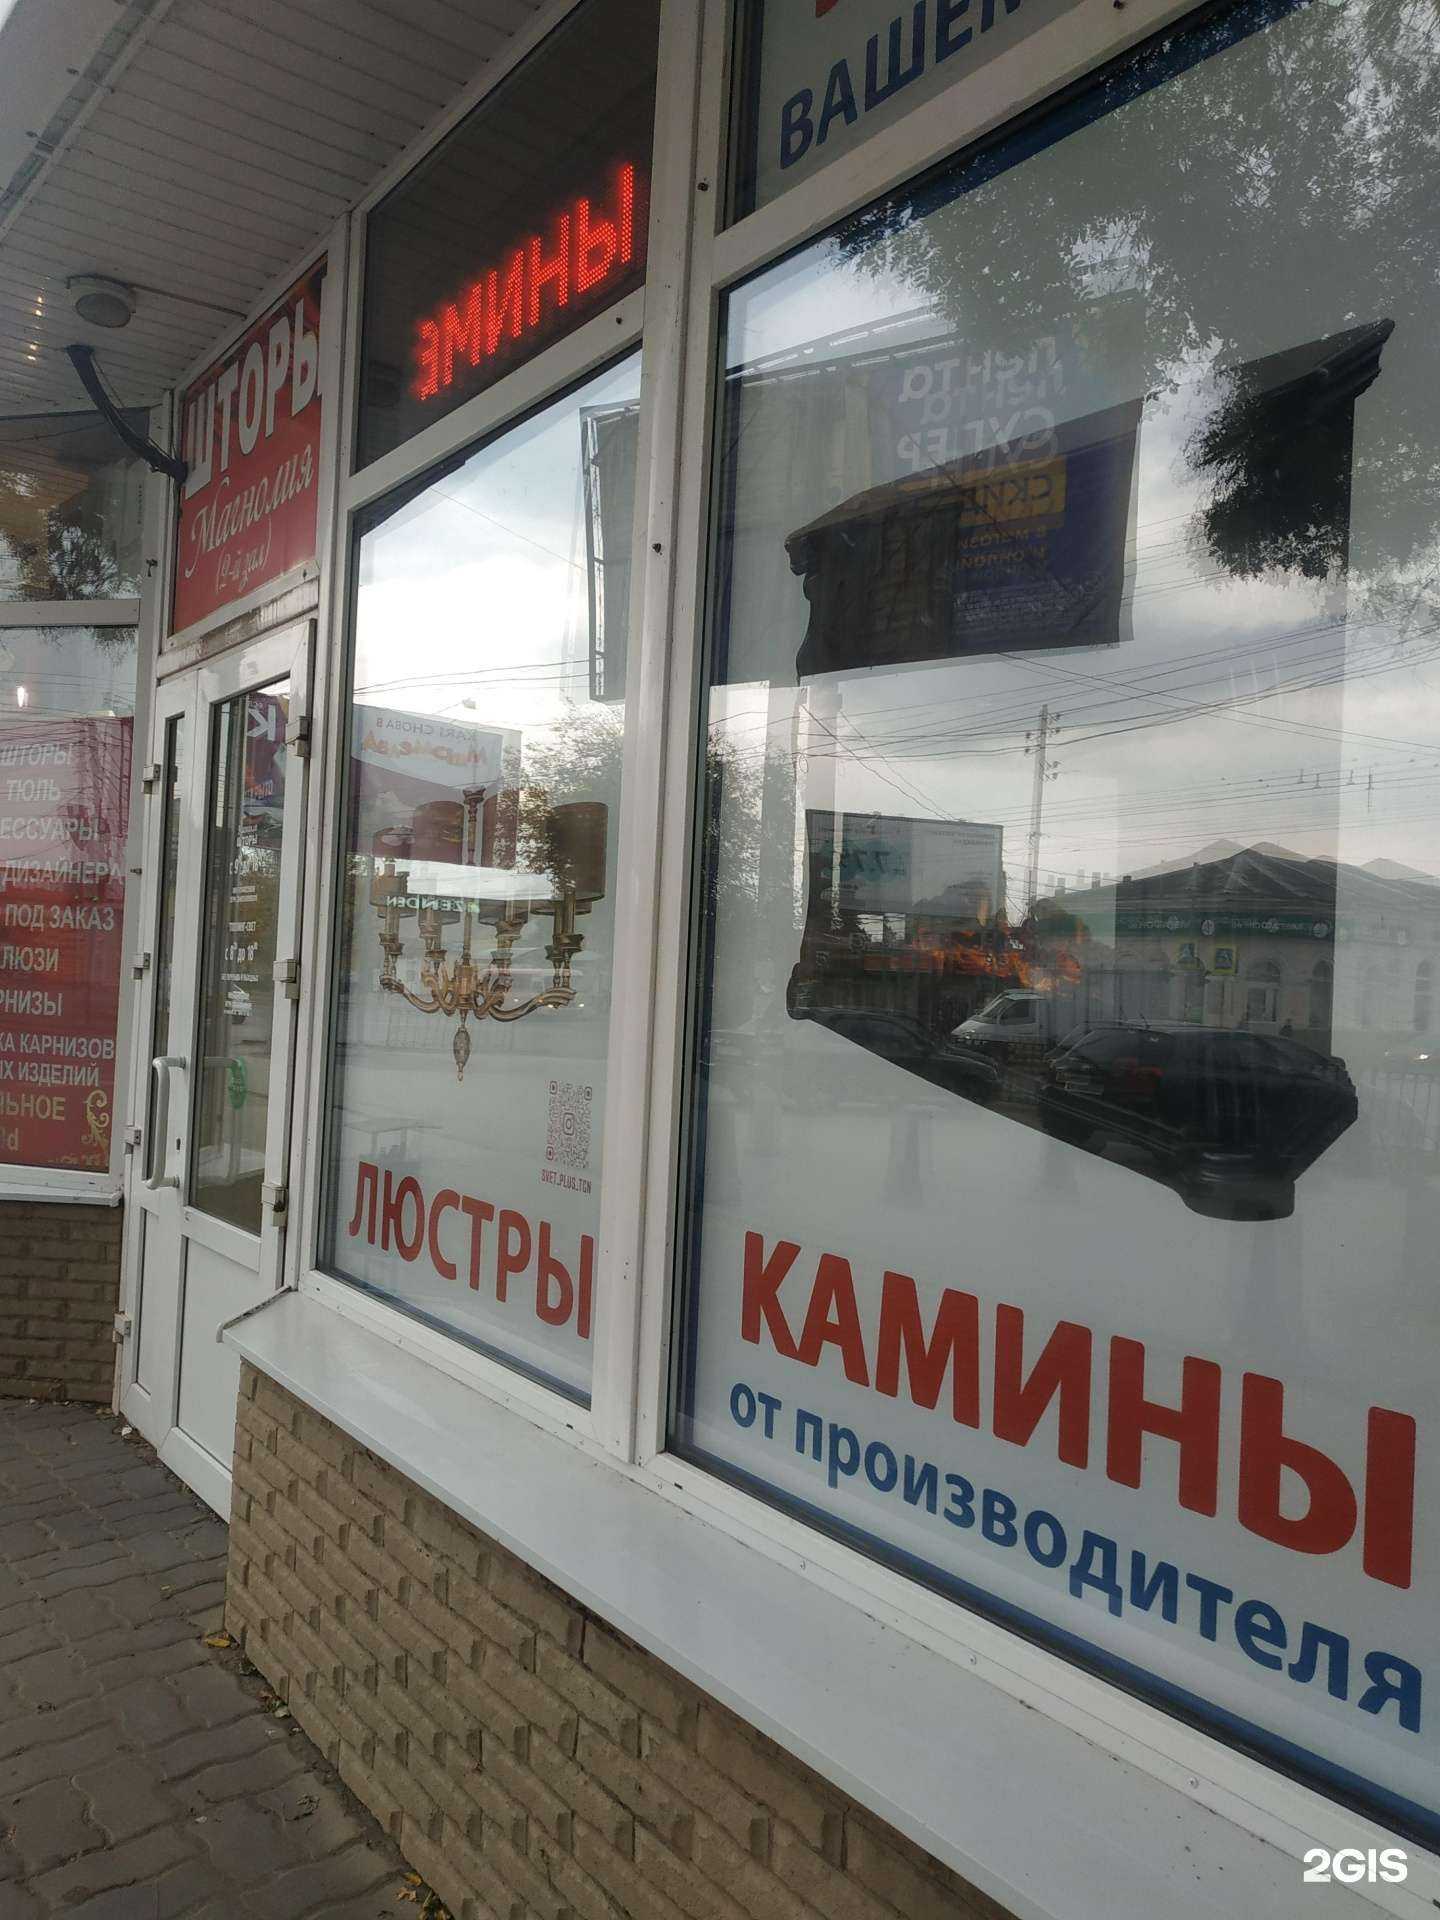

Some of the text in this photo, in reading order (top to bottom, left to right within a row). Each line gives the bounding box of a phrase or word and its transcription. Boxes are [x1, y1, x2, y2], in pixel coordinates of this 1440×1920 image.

[184, 272, 324, 500] ШТОРЫ
[184, 443, 313, 578] Магнолия
[6, 778, 62, 802] ТЮЛЬ
[3, 855, 124, 888] ДИЗАЙНЕРА
[5, 903, 115, 933] ПОД ЗАКАЗ
[0, 945, 60, 972] ЛЮЗИ
[20, 1033, 115, 1060] КАРНИЗОВ
[18, 1061, 100, 1087] ИЗДЕЛИЙ
[349, 1160, 594, 1340] ЛЮСТРЫ
[741, 1230, 1417, 1590] КАМИНЫ
[729, 1382, 1422, 1734] от производителя
